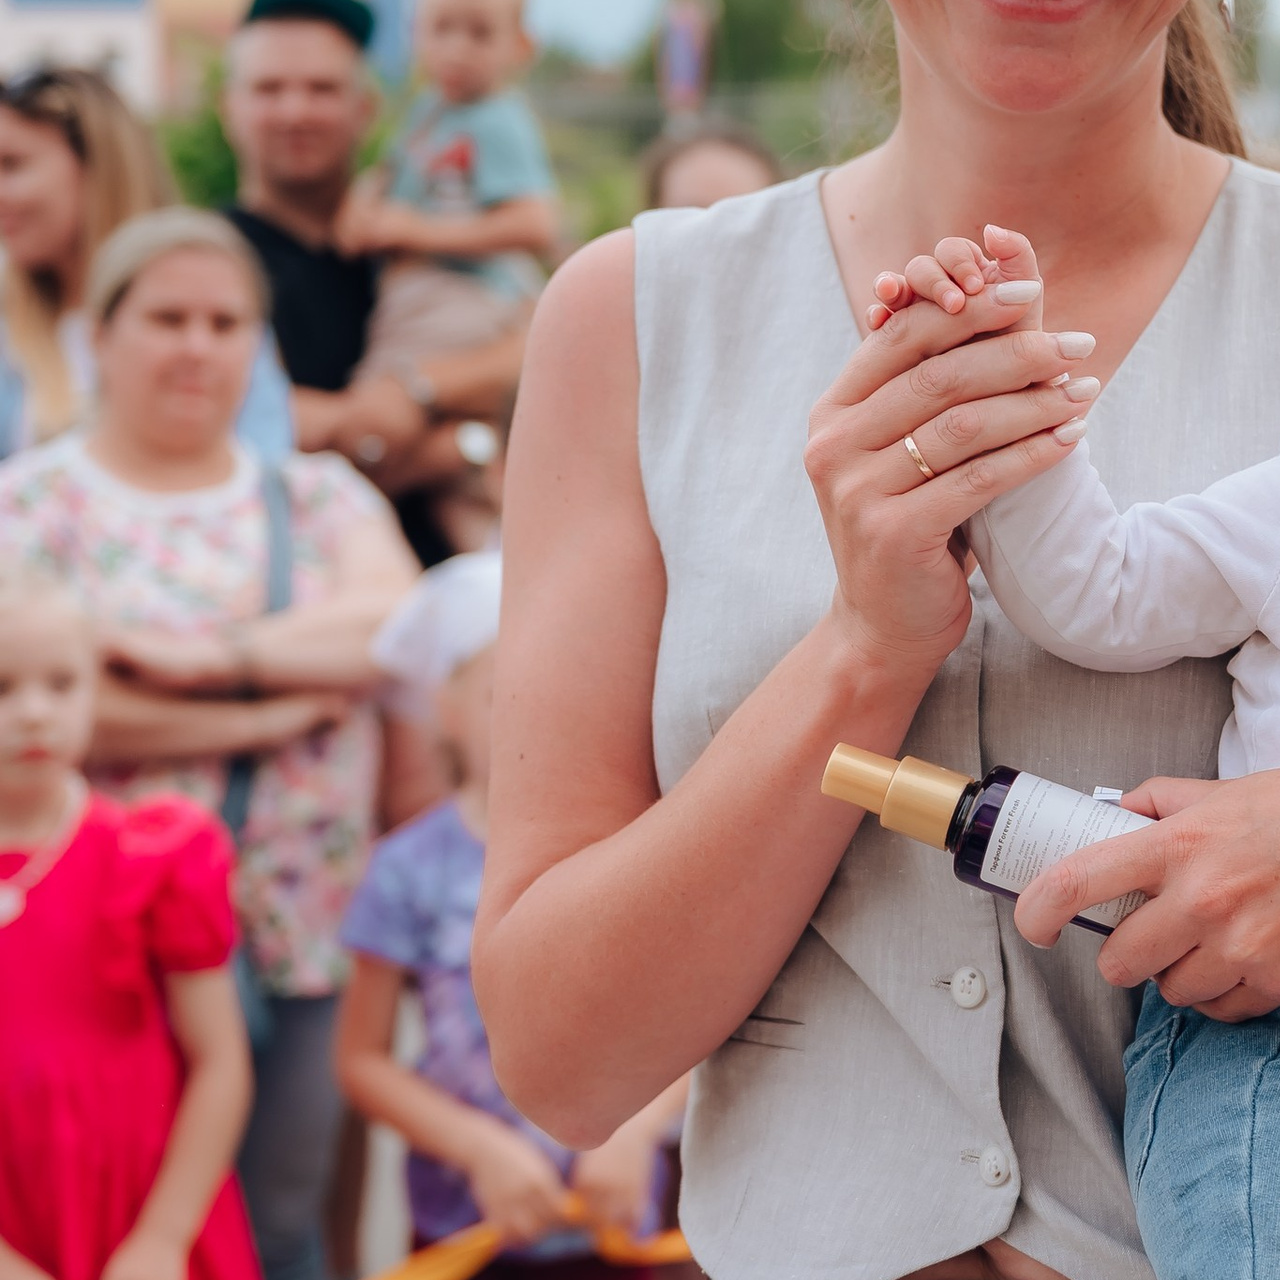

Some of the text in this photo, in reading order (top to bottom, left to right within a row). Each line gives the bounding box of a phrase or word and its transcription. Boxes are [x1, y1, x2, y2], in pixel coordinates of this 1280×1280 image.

[990, 799, 1020, 873] Парфюм Forever Fresh
